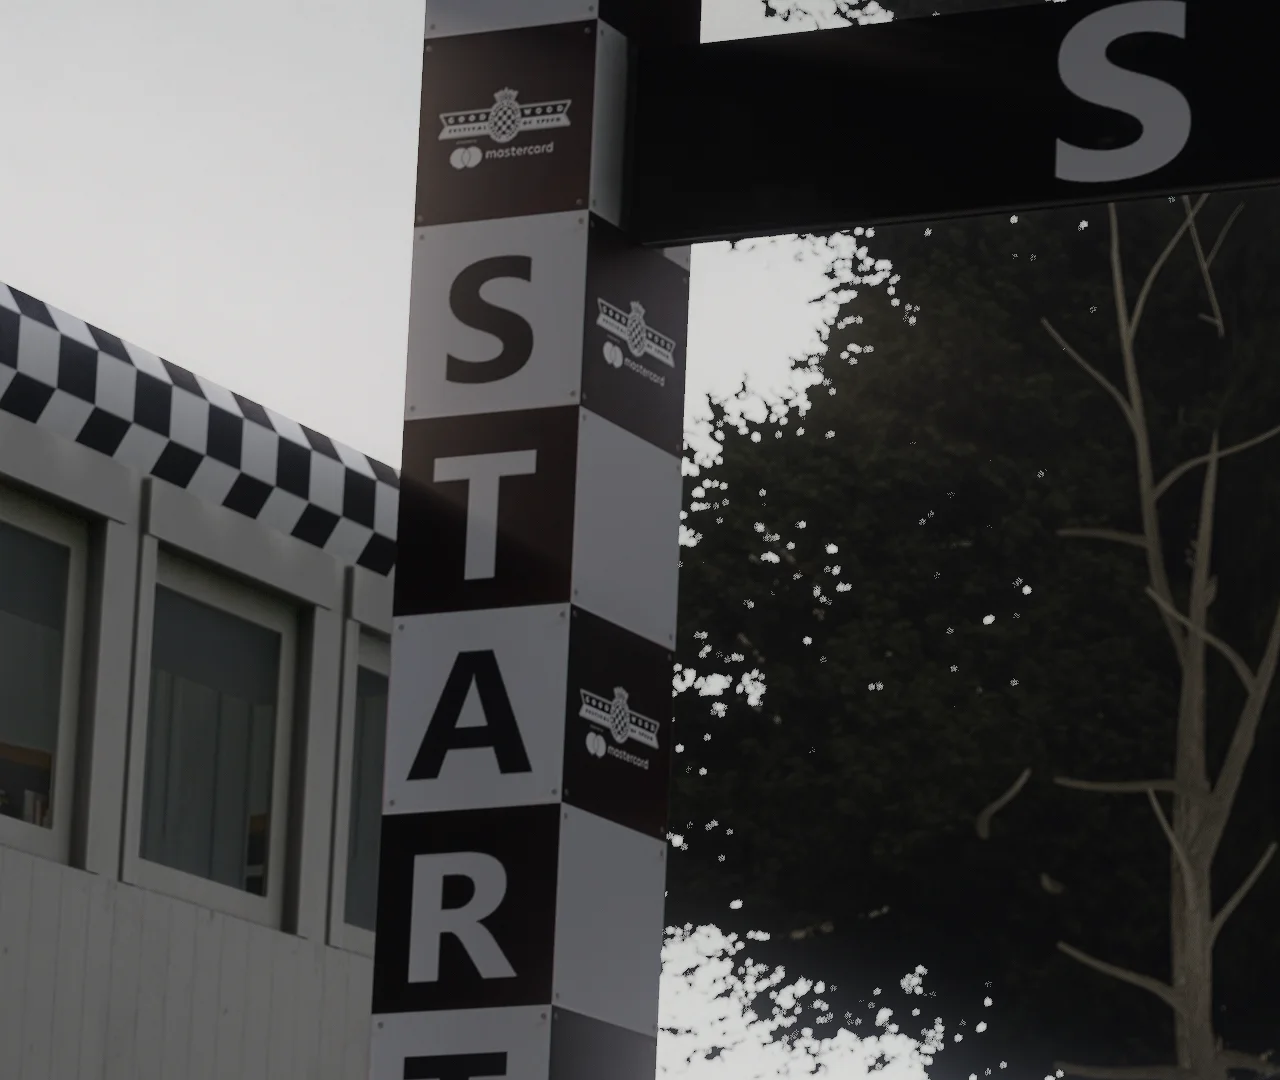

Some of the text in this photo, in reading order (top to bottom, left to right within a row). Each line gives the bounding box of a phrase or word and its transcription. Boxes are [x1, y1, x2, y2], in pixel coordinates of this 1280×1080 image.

[485, 142, 554, 159] mastercard
[624, 357, 665, 387] mastercard
[607, 745, 650, 770] mastercard
